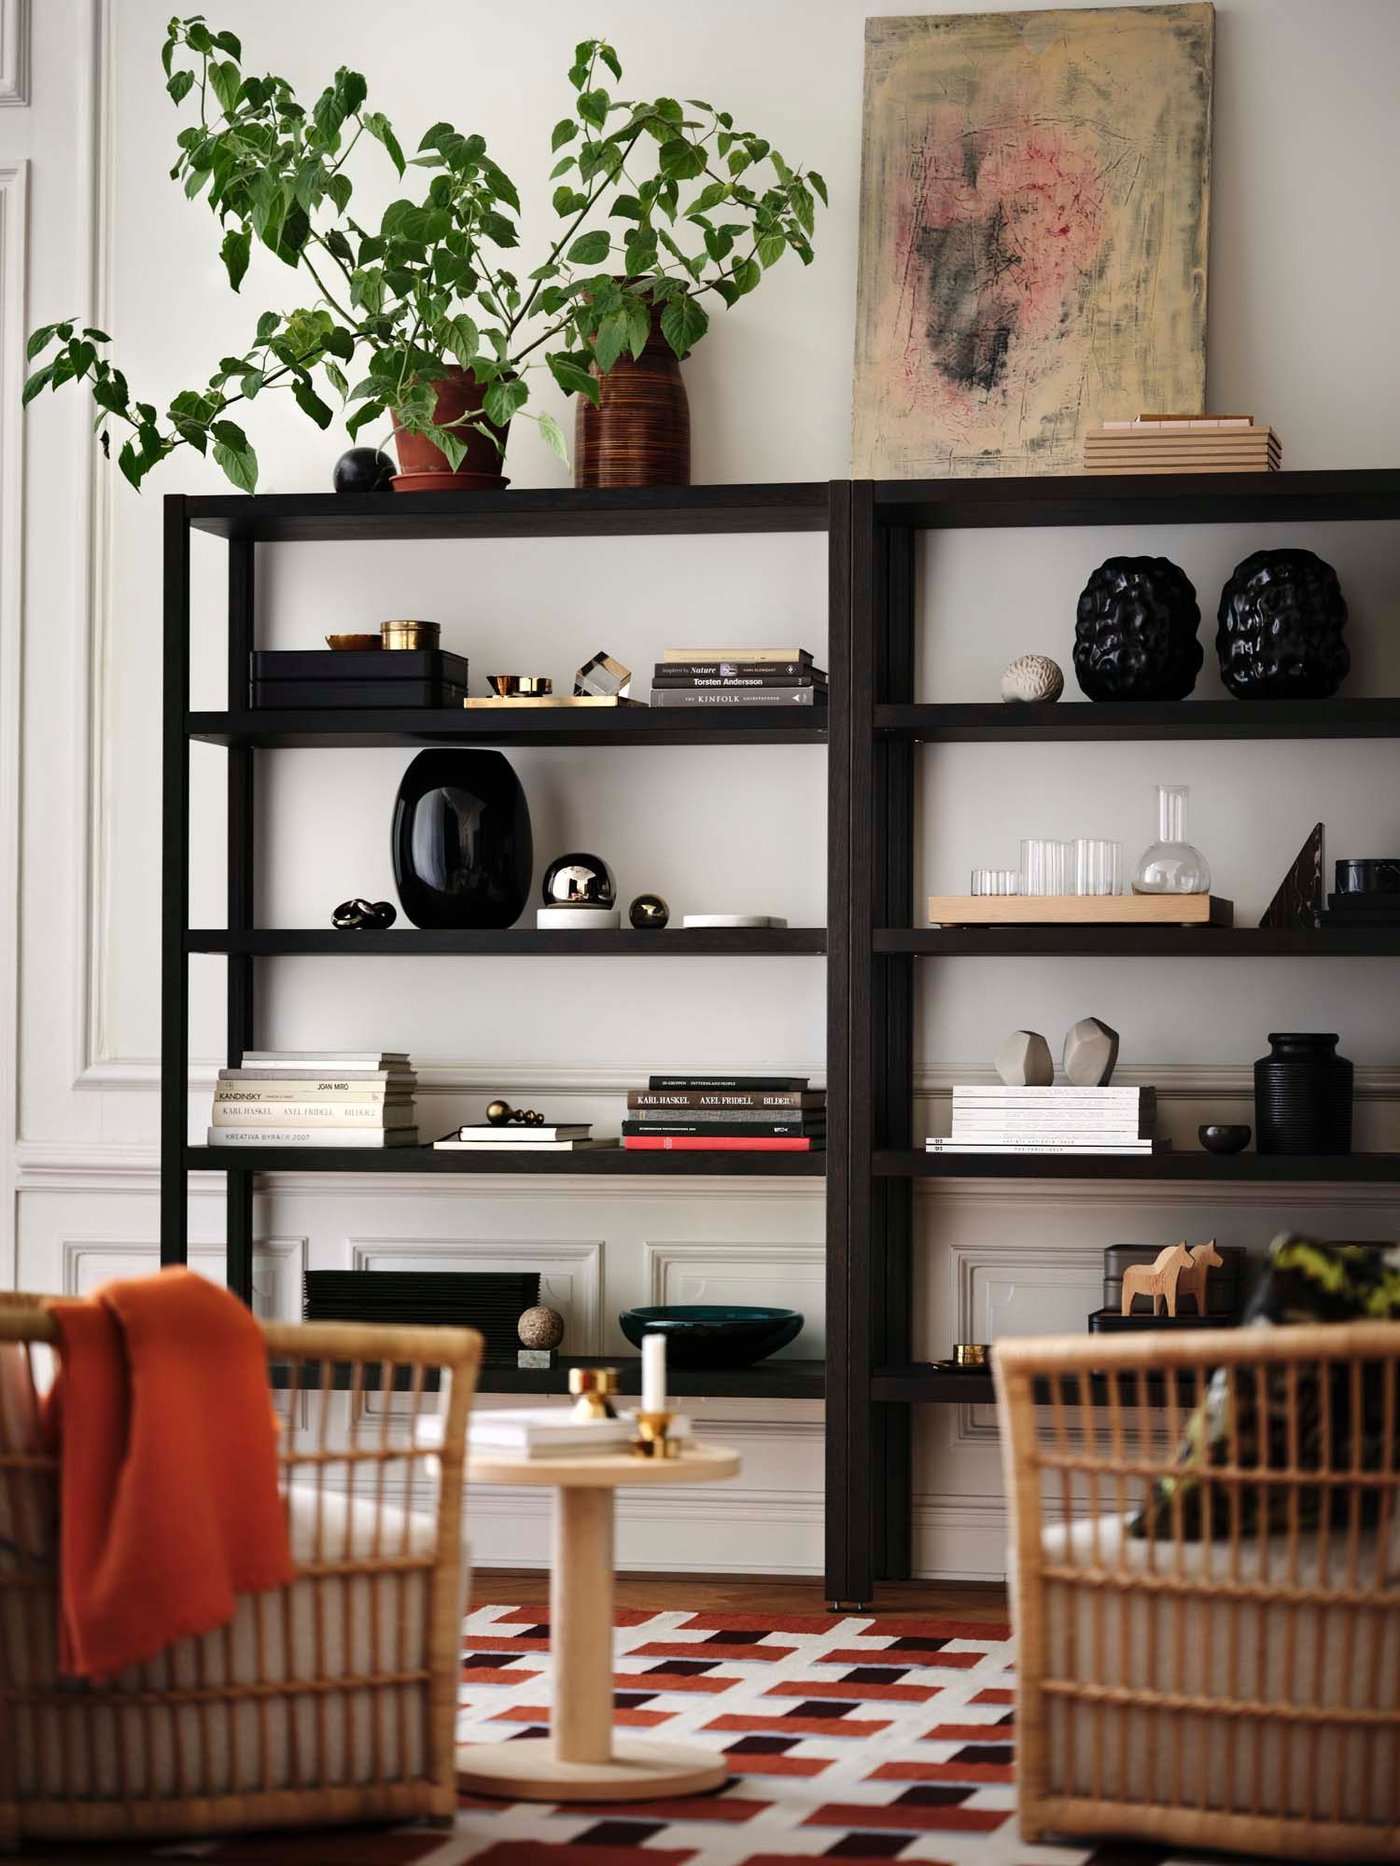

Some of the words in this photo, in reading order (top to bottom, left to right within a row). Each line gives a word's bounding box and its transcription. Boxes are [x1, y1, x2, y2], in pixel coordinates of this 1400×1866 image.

[690, 666, 716, 675] Nature
[694, 678, 721, 686] Torsten
[723, 678, 763, 686] Andersson
[698, 695, 740, 703] KINFOLK
[317, 1083, 333, 1091] JOAN
[637, 1096, 659, 1105] KARL
[660, 1096, 690, 1105] HASKEL
[700, 1096, 720, 1105] AXEL
[721, 1096, 754, 1105] FRIDELL
[763, 1096, 790, 1105] BILDER
[223, 1107, 243, 1116] KARL
[243, 1107, 272, 1116] HASKEL
[284, 1108, 301, 1116] AXEL
[304, 1108, 335, 1117] FRIDELL
[225, 1133, 259, 1141] KREATIVA
[292, 1134, 310, 1142] 2007
